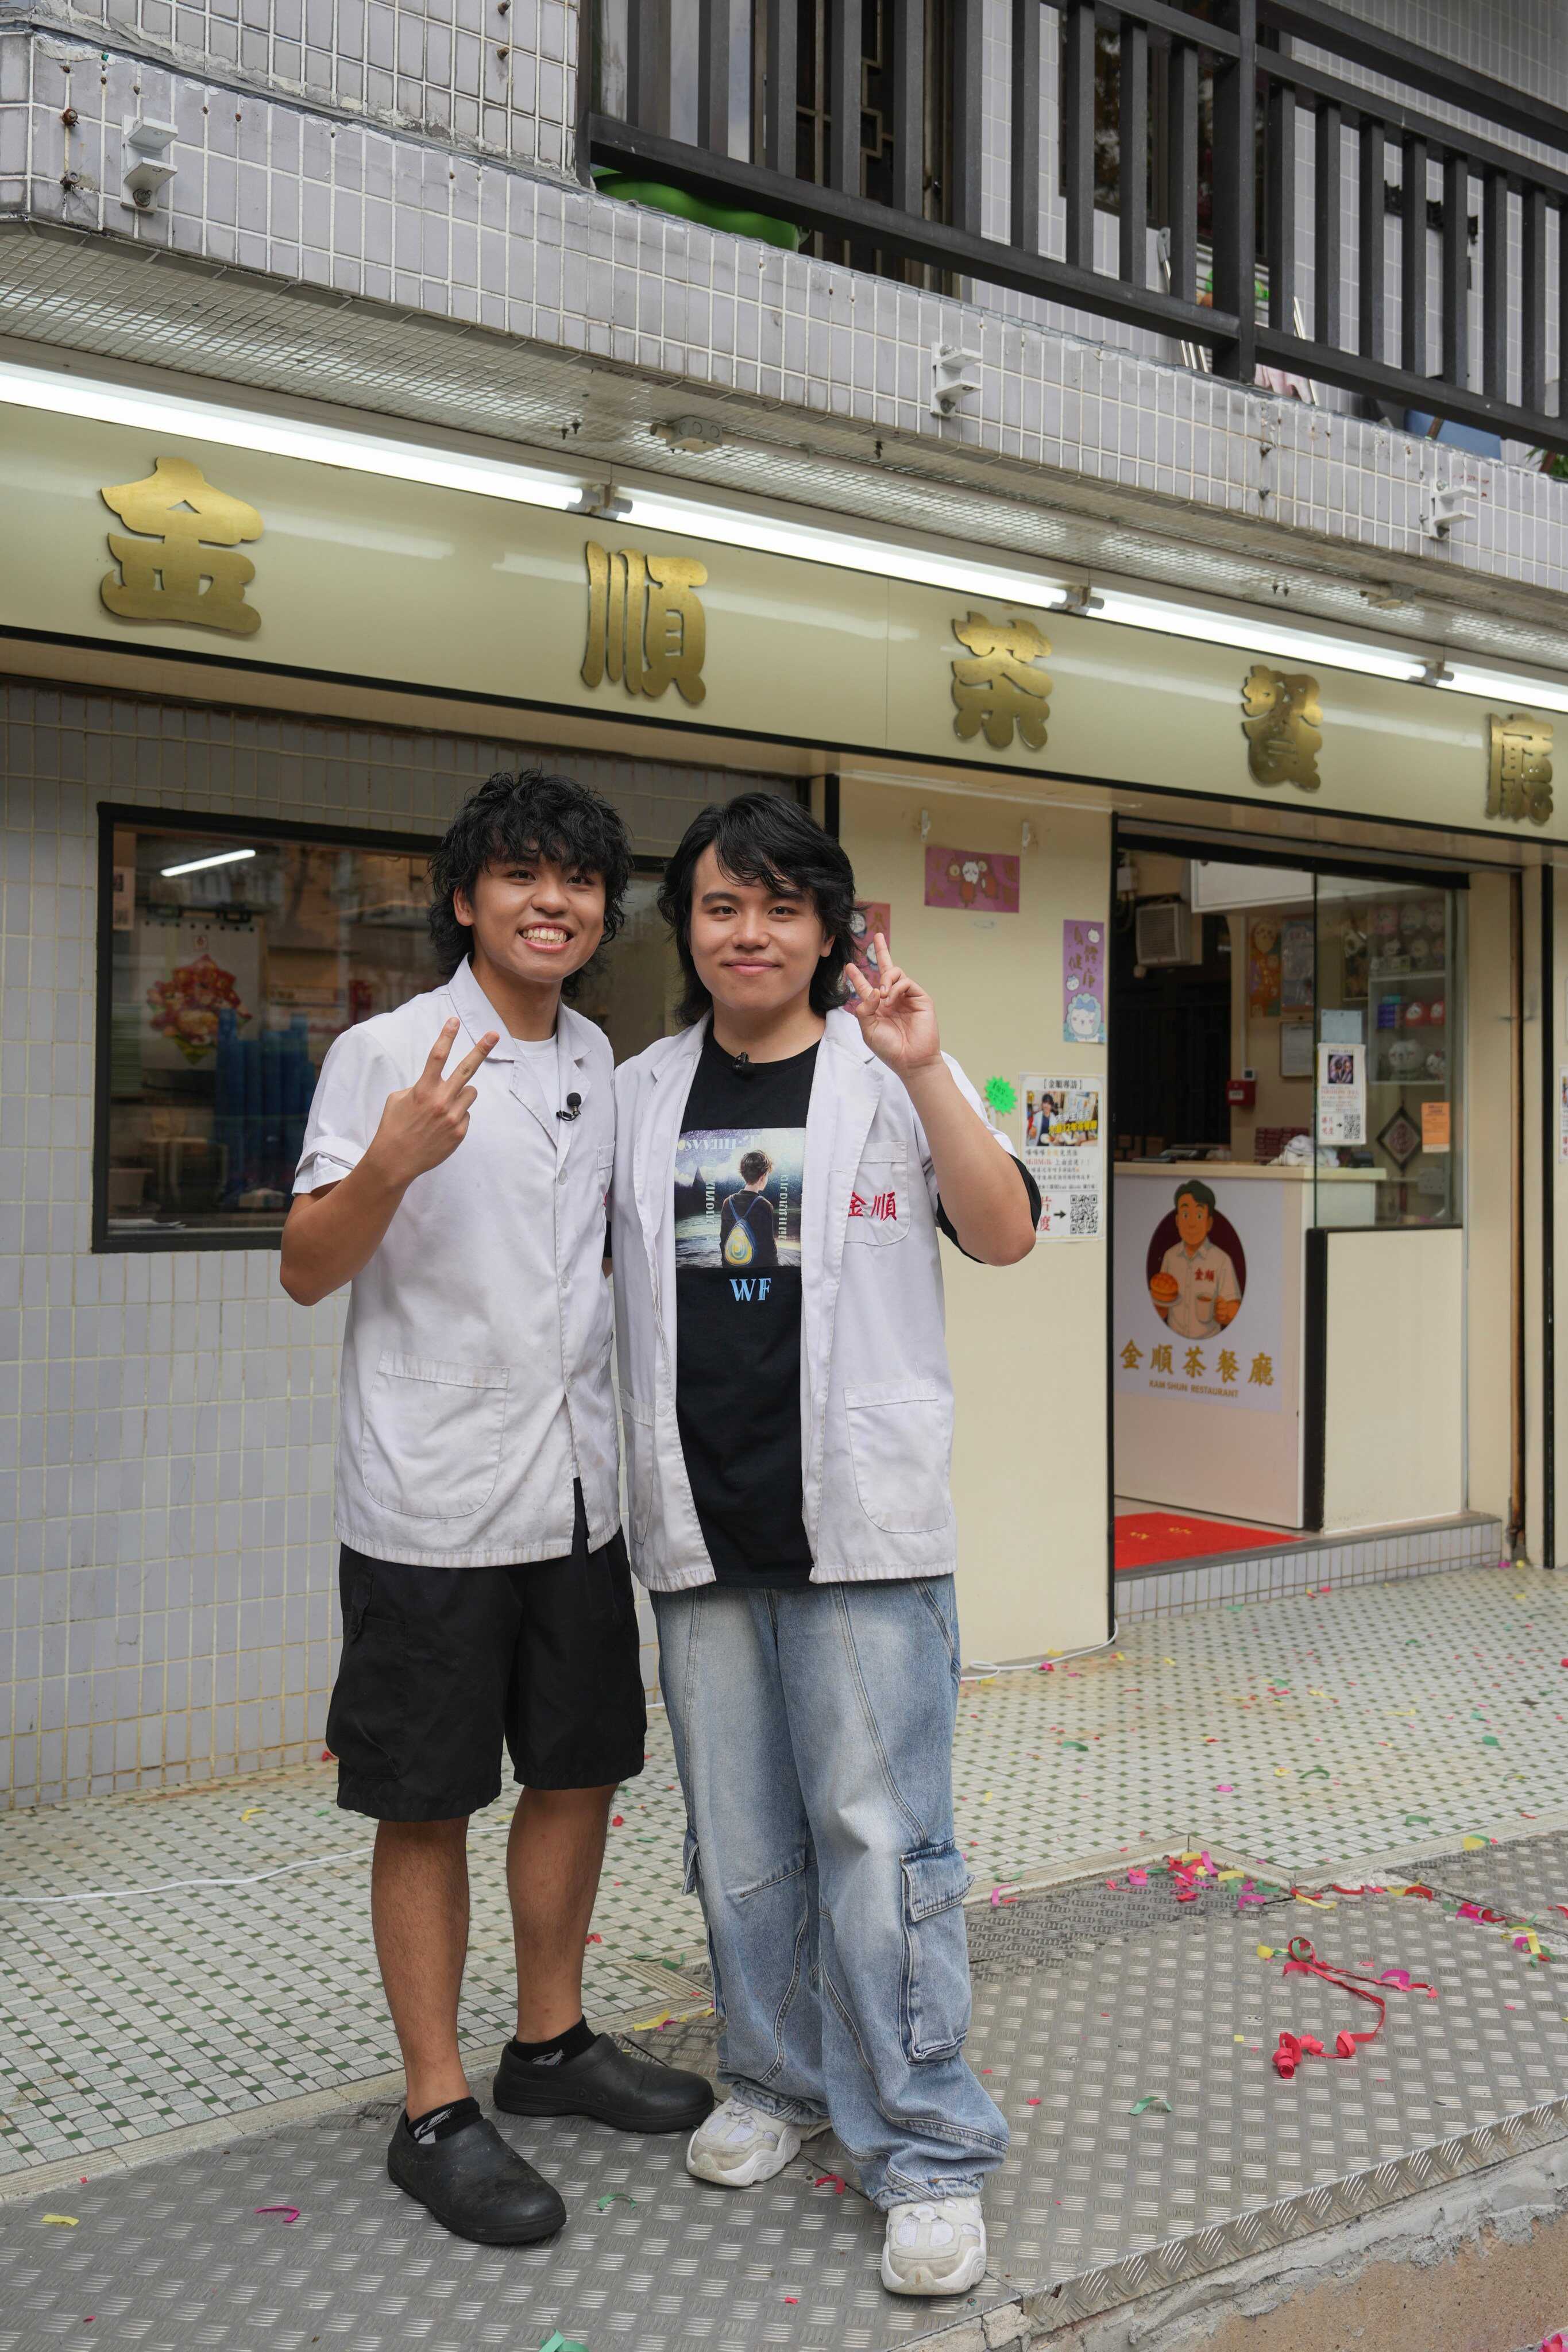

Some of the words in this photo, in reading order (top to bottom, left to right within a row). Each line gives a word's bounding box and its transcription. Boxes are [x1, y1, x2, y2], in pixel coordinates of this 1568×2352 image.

[99, 456, 1554, 825] 金順茶餐廳
[848, 1191, 897, 1222] 金順
[729, 1277, 771, 1302] WF
[1119, 1339, 1275, 1387] 金順茶餐廳
[1149, 1379, 1165, 1389] KAM
[1167, 1381, 1188, 1392] SHUN
[1190, 1384, 1239, 1398] RESTAURANT
